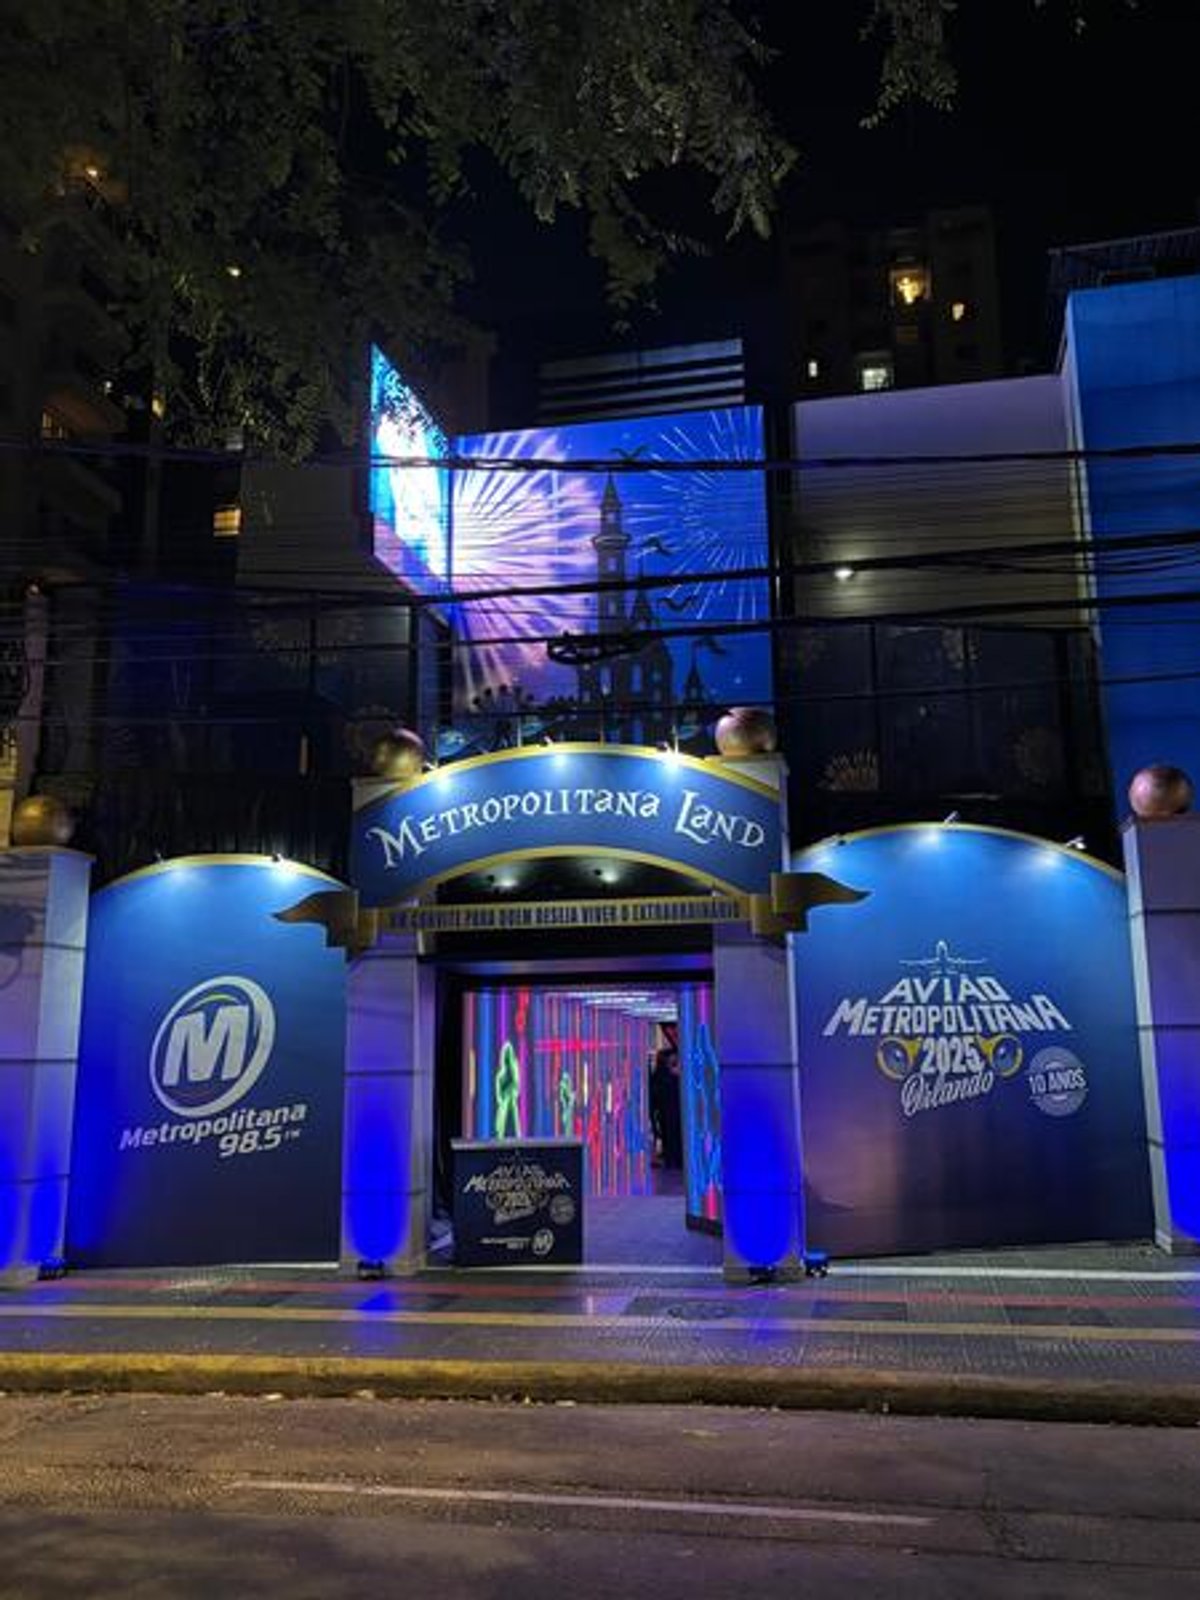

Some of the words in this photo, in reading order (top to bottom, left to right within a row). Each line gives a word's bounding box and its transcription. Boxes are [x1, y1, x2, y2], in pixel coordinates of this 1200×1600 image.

[822, 995, 1072, 1037] METROPOLITANA
[921, 1036, 981, 1074] 2025
[119, 1103, 307, 1150] Metropolitana
[218, 1126, 282, 1158] 98.5
